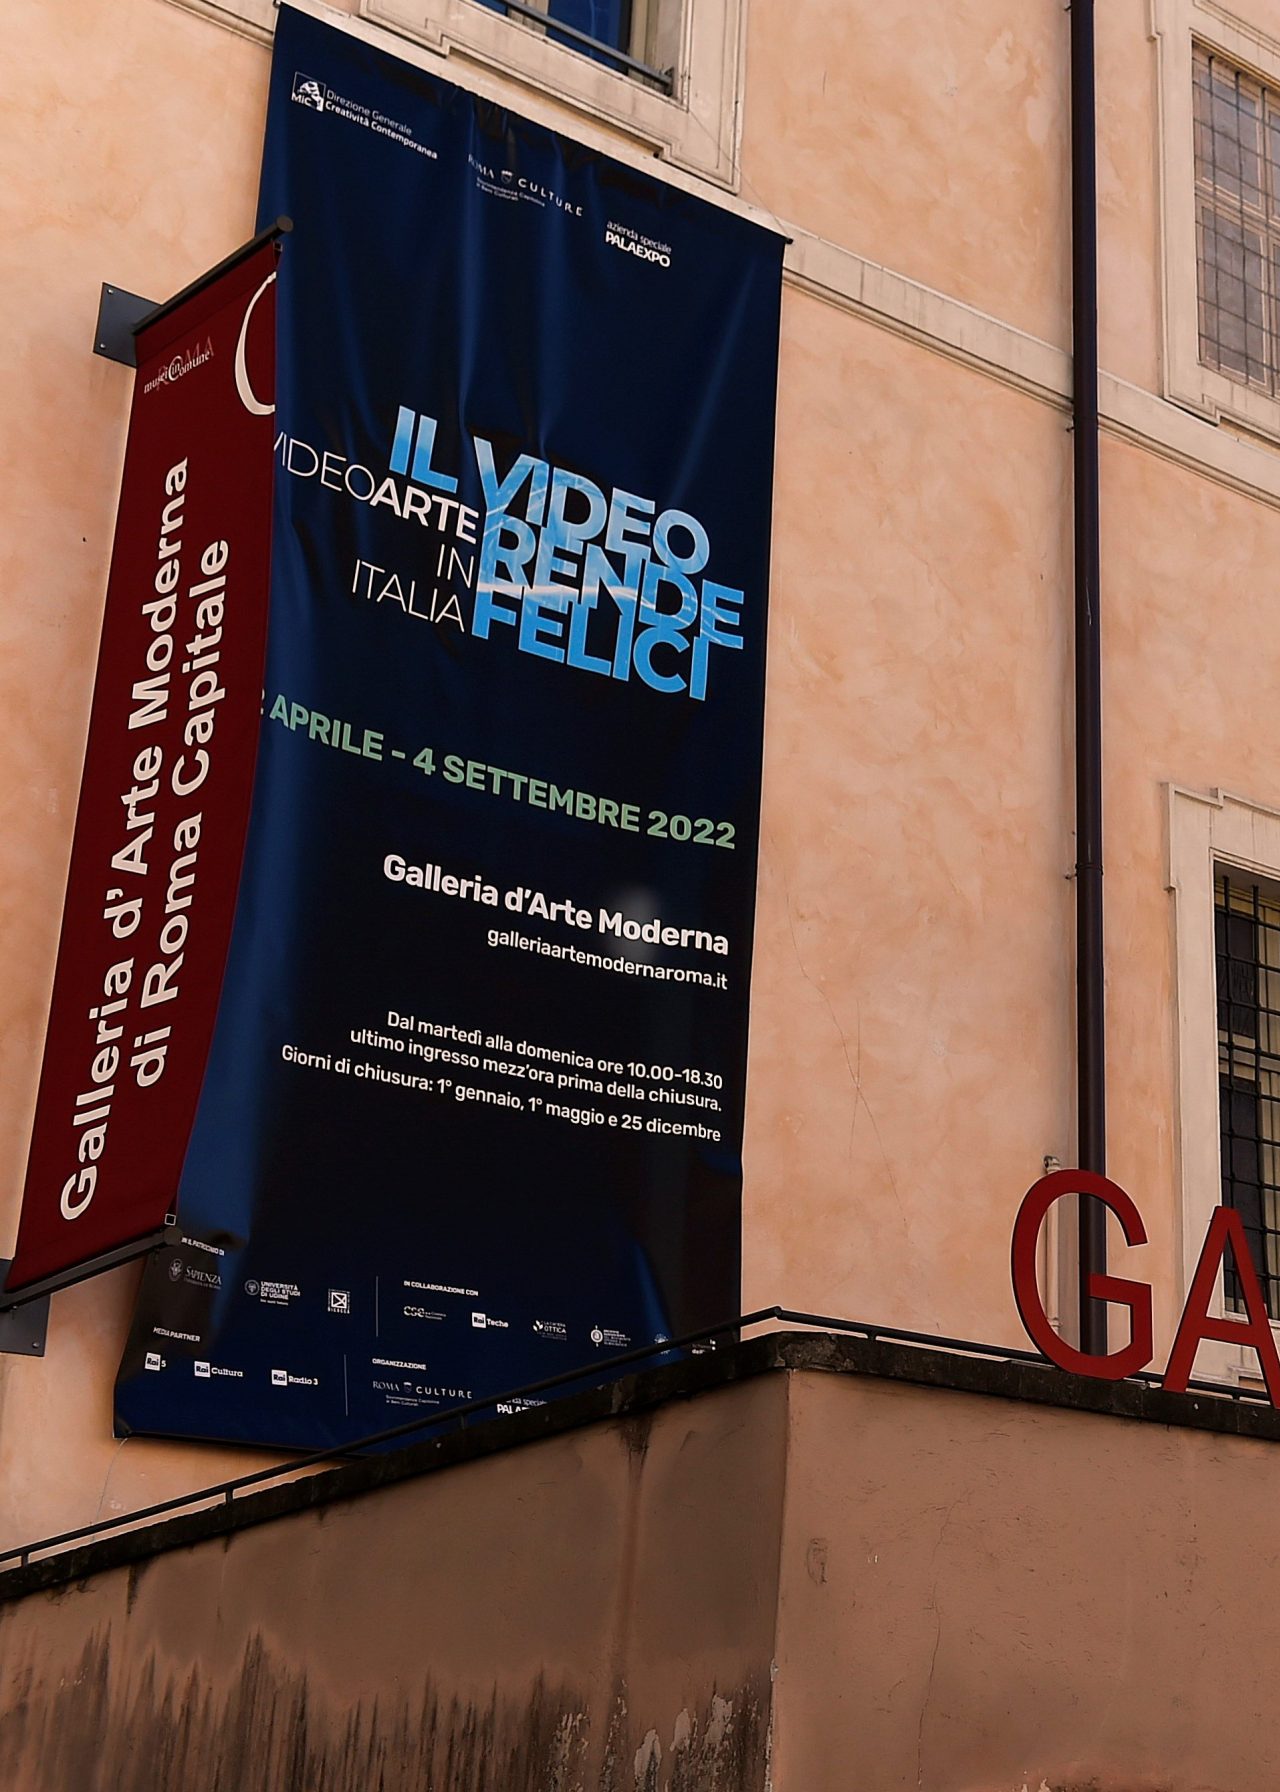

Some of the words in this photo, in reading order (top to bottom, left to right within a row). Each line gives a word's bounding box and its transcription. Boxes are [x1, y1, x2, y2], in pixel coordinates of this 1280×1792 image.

[325, 100, 369, 127] Creatività
[371, 121, 438, 160] Contemporanea
[326, 89, 371, 117] Direzione
[372, 110, 412, 136] Generale
[518, 178, 583, 217] CULTURE
[605, 230, 671, 268] PALAEXPO
[606, 220, 638, 240] azienda
[640, 235, 672, 255] speciale
[388, 405, 458, 494] IL
[473, 435, 710, 575] VIDEO
[128, 457, 189, 731] Moderna
[351, 558, 465, 633] ITALIA
[436, 544, 475, 589] IN
[477, 513, 744, 650] RENDE
[171, 539, 230, 797] Capitale
[471, 586, 710, 702] FELICI
[269, 694, 384, 761] APRILE
[413, 747, 436, 775] 4
[443, 755, 640, 832] SETTEMBRE
[647, 809, 736, 850] 2022
[103, 745, 164, 939] d'Arte
[140, 812, 203, 1001] Roma
[383, 853, 499, 907] Galleria
[504, 886, 593, 930] d'Arte
[598, 908, 729, 956] Moderna
[486, 927, 728, 990] galleriaartemodernaroma.it
[130, 1025, 173, 1088] di
[350, 1028, 405, 1053] ultimo
[408, 1038, 480, 1069] ingresso
[483, 1057, 555, 1084] mezz'ora
[557, 1070, 603, 1095] prima
[606, 1077, 646, 1101] della
[648, 1086, 723, 1112] chiusura.
[387, 1010, 414, 1030] Dal
[418, 1017, 482, 1047] martedì
[485, 1033, 513, 1053] alla
[516, 1037, 594, 1070] domenica
[597, 1058, 624, 1075] ore
[626, 1061, 723, 1091] 10.00-18.30
[60, 957, 136, 1221] Galleria
[281, 1043, 331, 1071] Giorni
[334, 1056, 351, 1075] di
[354, 1060, 434, 1092] chiusura:
[455, 1083, 525, 1112] gennaio,
[545, 1101, 605, 1127] maggio
[607, 1114, 619, 1127] e
[620, 1112, 643, 1131] 25
[645, 1116, 722, 1142] dicembre
[411, 1280, 465, 1296] COLLABORAZIONE
[466, 1288, 479, 1297] CON
[170, 1331, 201, 1342] PARTNER
[372, 1358, 427, 1370] ORGANIZZAZIONE
[211, 1366, 244, 1377] Cultura
[288, 1375, 313, 1385] Radio
[372, 1380, 400, 1392] ROMA
[415, 1386, 473, 1399] CULTURE
